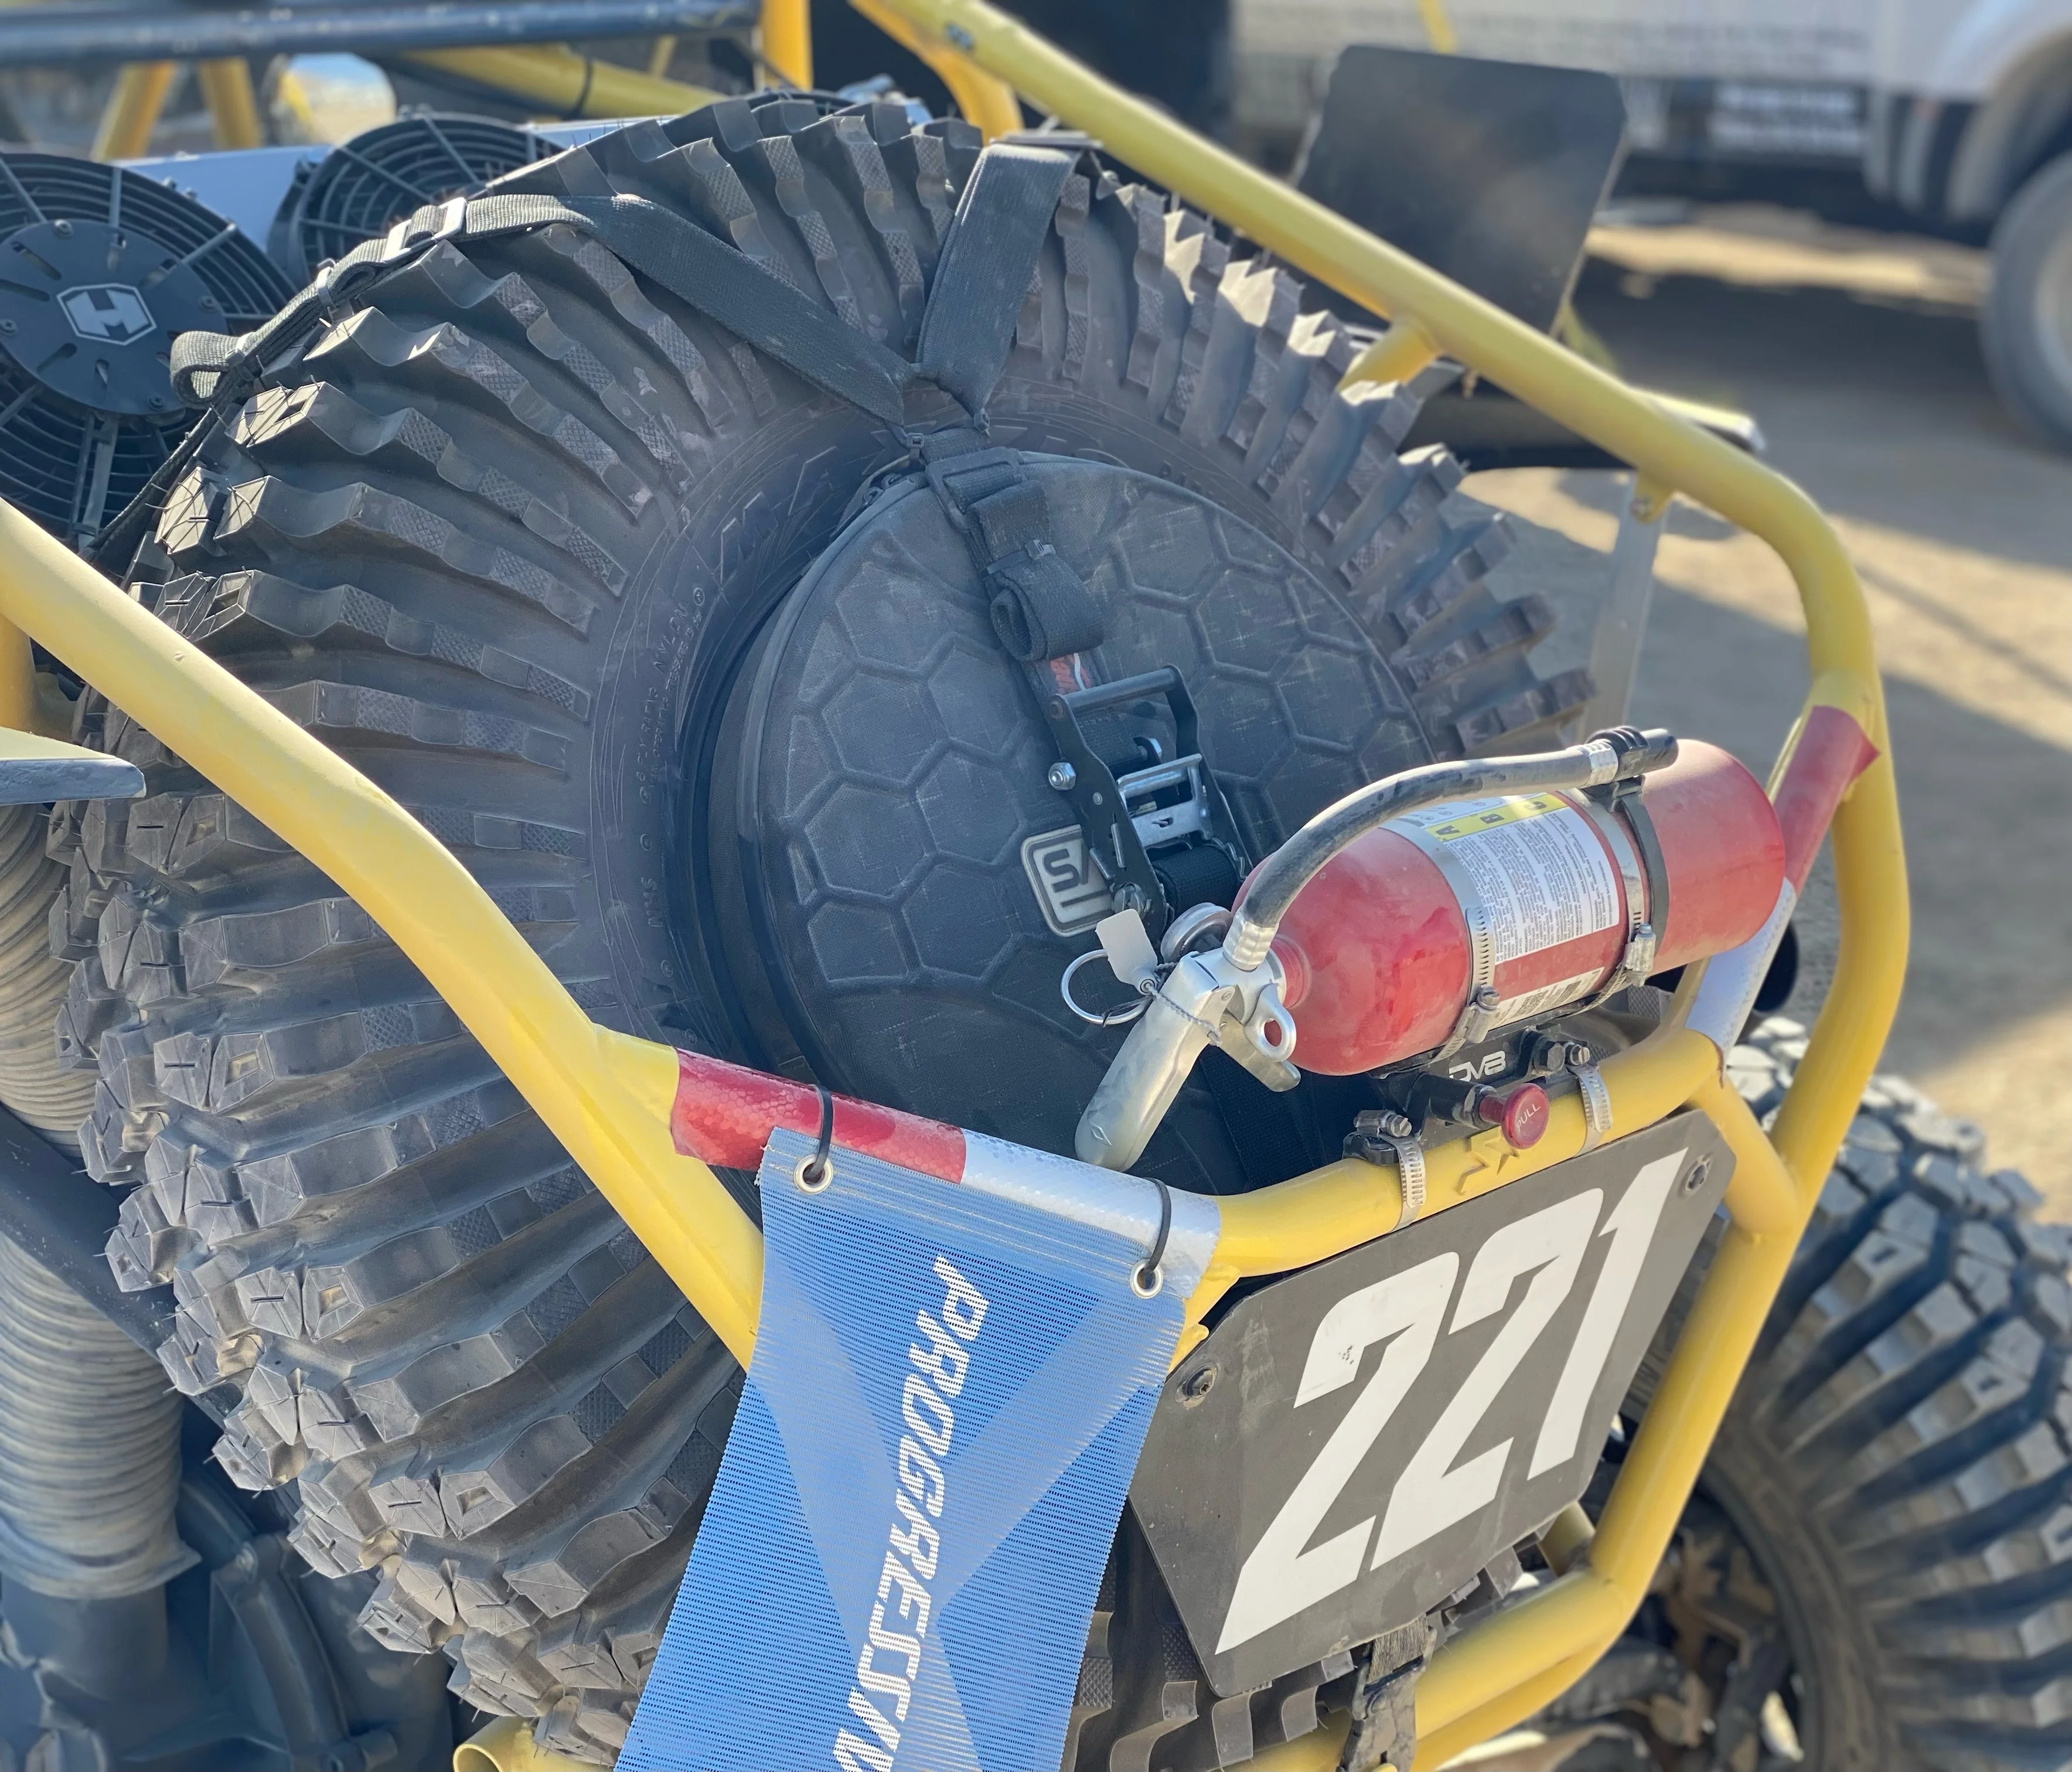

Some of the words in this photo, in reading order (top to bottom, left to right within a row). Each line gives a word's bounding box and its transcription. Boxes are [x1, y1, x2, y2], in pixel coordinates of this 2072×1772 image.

[1436, 824, 1461, 836] A
[1480, 813, 1505, 824] B
[1524, 800, 1547, 810] C
[1516, 1103, 1541, 1132] PULL
[1215, 1146, 1688, 1655] 221
